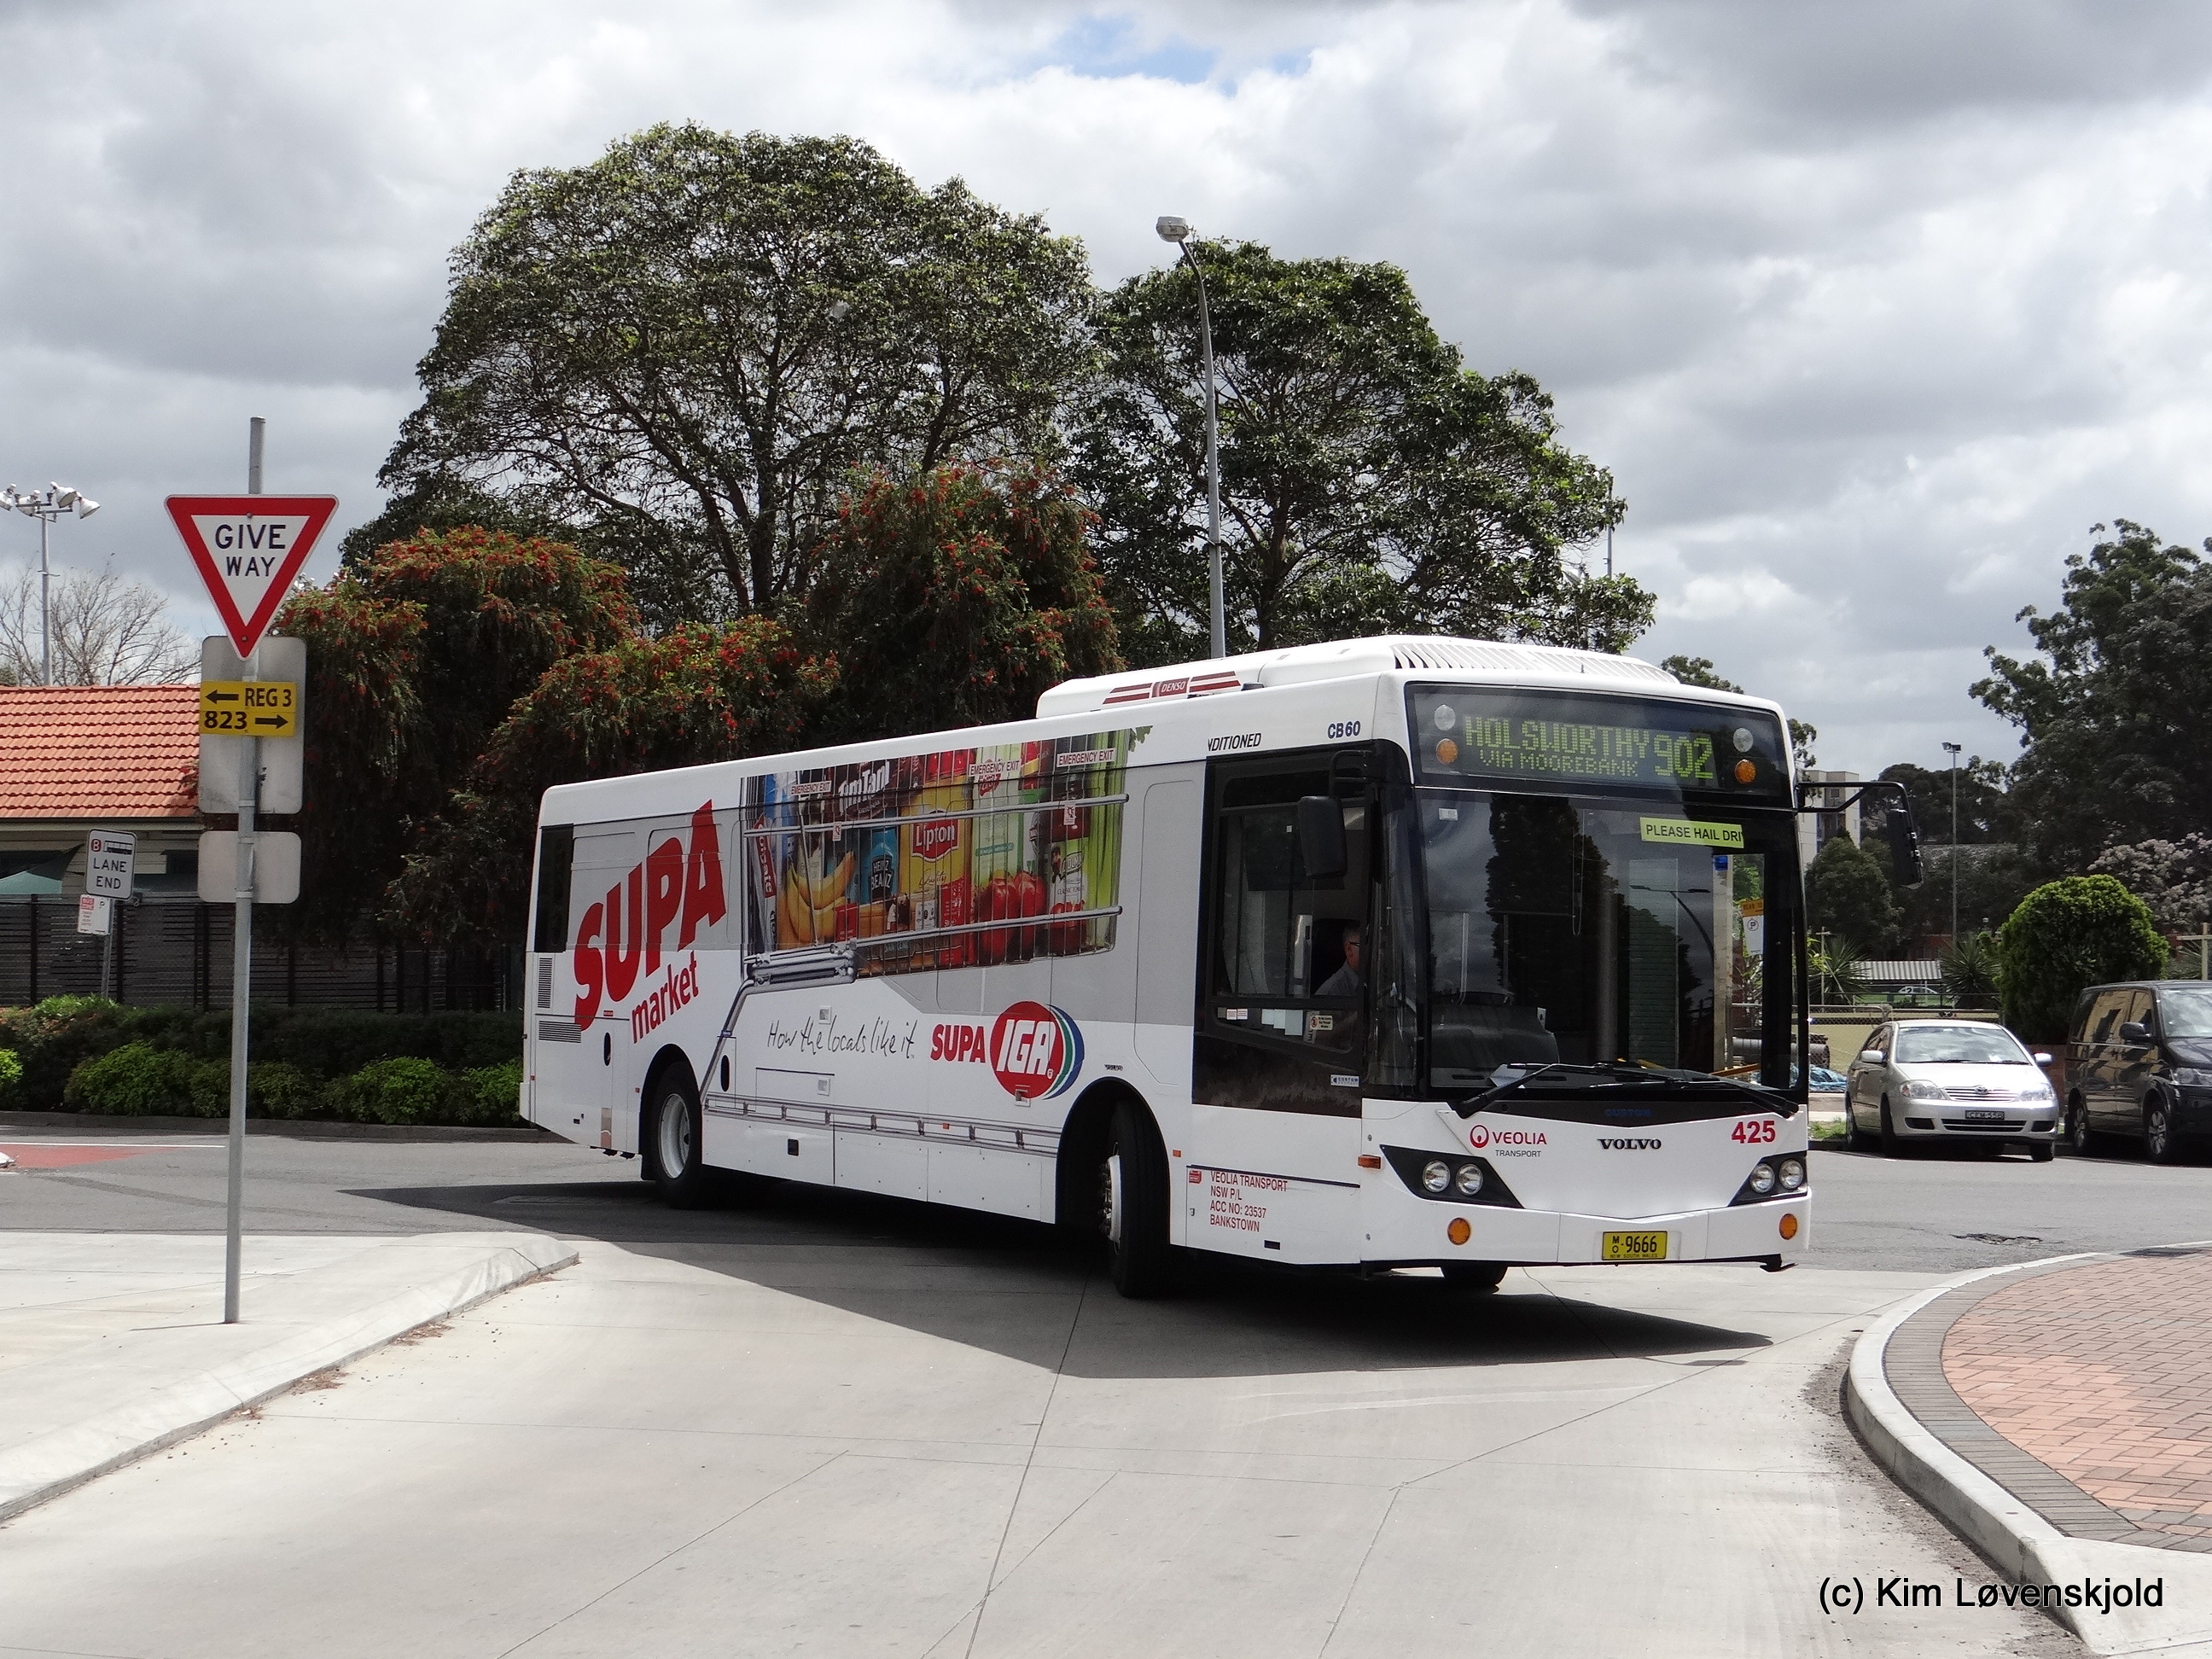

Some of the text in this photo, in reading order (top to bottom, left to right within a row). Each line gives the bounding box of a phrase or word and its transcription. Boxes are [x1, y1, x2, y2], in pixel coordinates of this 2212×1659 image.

[215, 524, 286, 549] GIVE
[226, 556, 276, 577] WAY
[1161, 681, 1185, 693] DENSO
[244, 688, 292, 707] REG 3
[204, 711, 247, 730] 823
[1464, 716, 1714, 779] HOLSWORTHY 902
[1059, 752, 1098, 765] EMERGENCY
[1099, 750, 1114, 761] EXIT
[1479, 748, 1639, 777] VIA MOOREBANK
[970, 760, 1020, 775] EMERGENCY EXIT
[791, 781, 830, 795] EMERGENCY EXIT
[916, 825, 955, 852] Lipton
[1646, 824, 1691, 839] PLEASE
[1693, 828, 1720, 841] HAIL
[93, 858, 126, 873] LANE
[96, 876, 121, 889] END
[573, 799, 726, 1033] SUPA
[632, 950, 699, 1044] market
[768, 1020, 797, 1049] How
[800, 1016, 824, 1055] the
[828, 1015, 867, 1053] locals
[870, 1016, 897, 1057] like
[930, 1024, 986, 1063] SUPA
[997, 1019, 1057, 1076] IGA
[1493, 1132, 1546, 1145] VEOLIA
[1732, 1121, 1776, 1144] 425
[1598, 1138, 1662, 1150] VOLVO
[1495, 1150, 1541, 1158] TRANSPORT
[1211, 1171, 1238, 1185] VEOLIA
[1240, 1175, 1288, 1191] TRANSPORT
[1211, 1185, 1242, 1200] NSW P/L
[1210, 1200, 1266, 1218] ACC NO: 23537
[1210, 1214, 1260, 1231] BANKSTOWN
[1626, 1236, 1657, 1253] 9666
